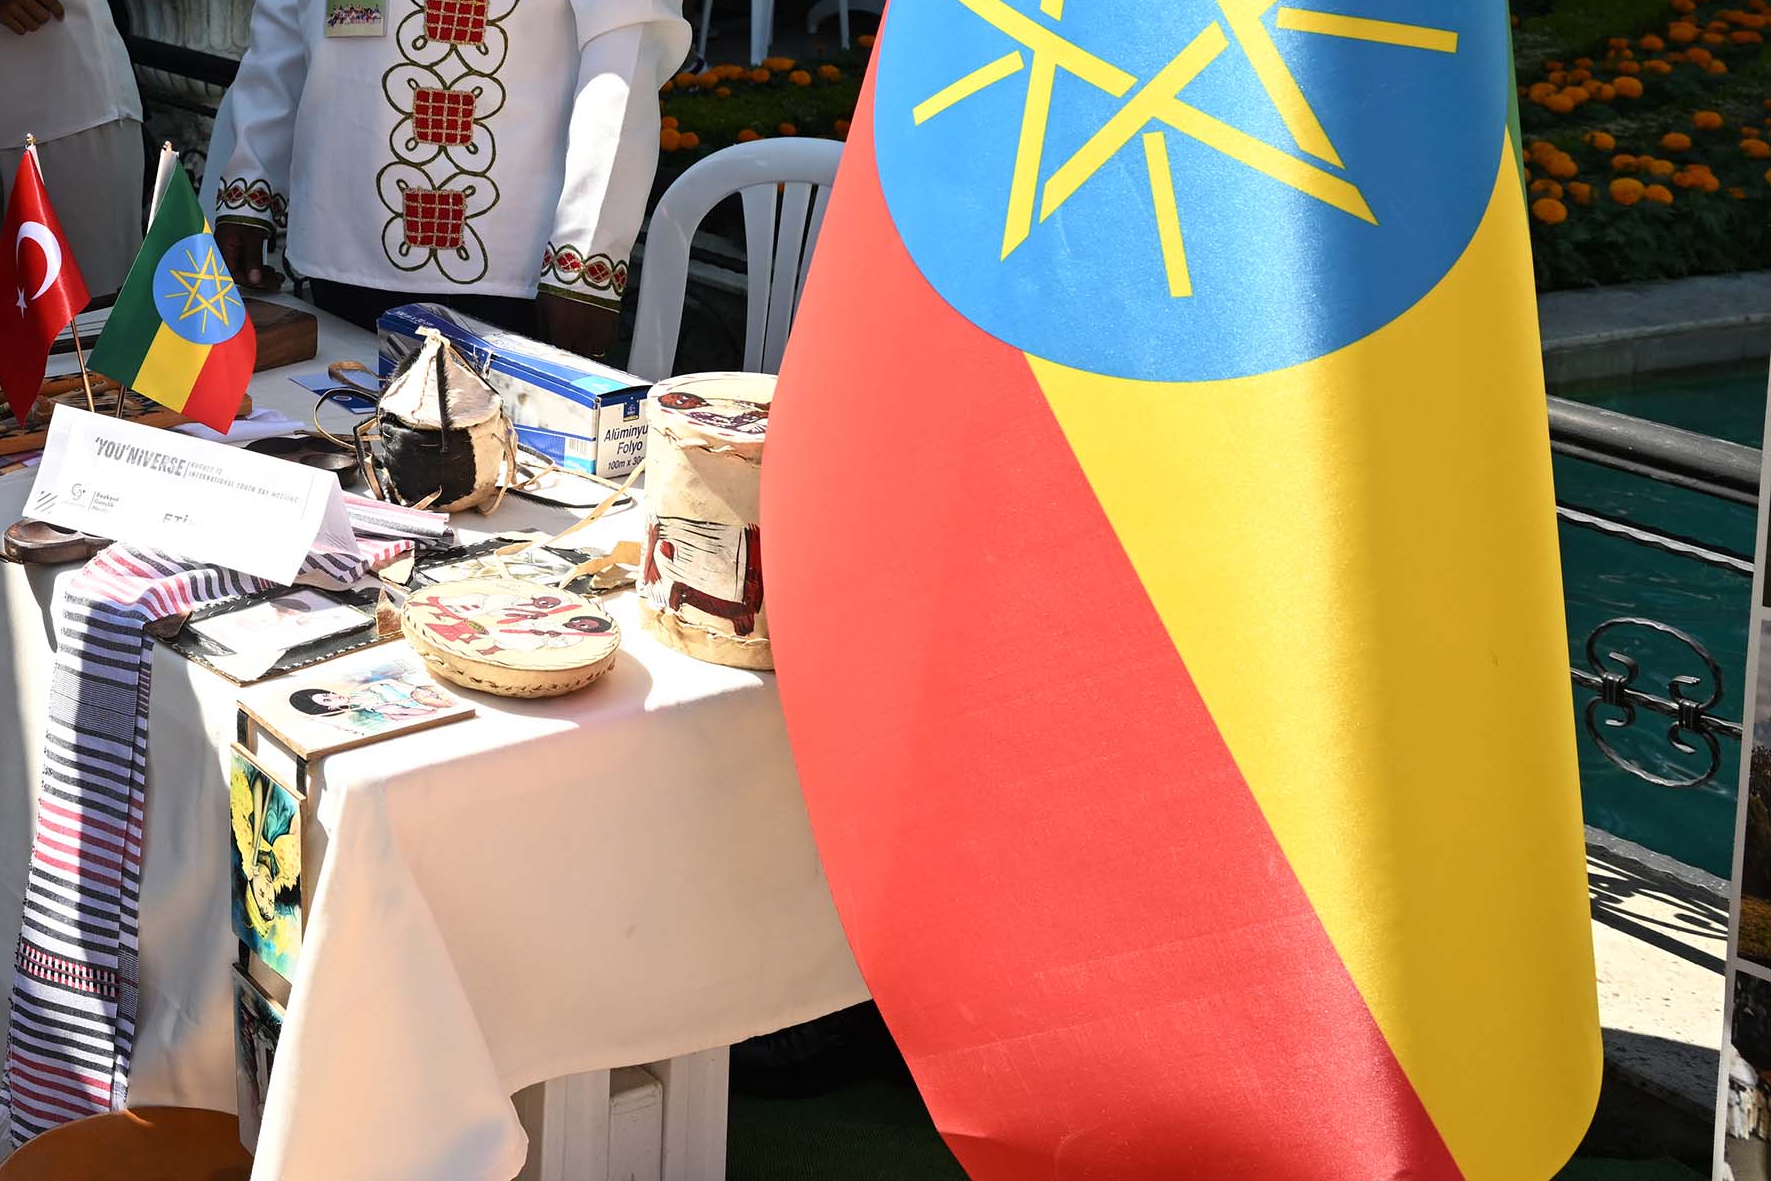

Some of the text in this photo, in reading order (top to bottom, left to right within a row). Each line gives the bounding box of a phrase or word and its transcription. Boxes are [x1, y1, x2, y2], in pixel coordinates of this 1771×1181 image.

[603, 424, 649, 443] Alüminyu
[616, 440, 643, 456] Folyo
[608, 459, 626, 471] 100m
